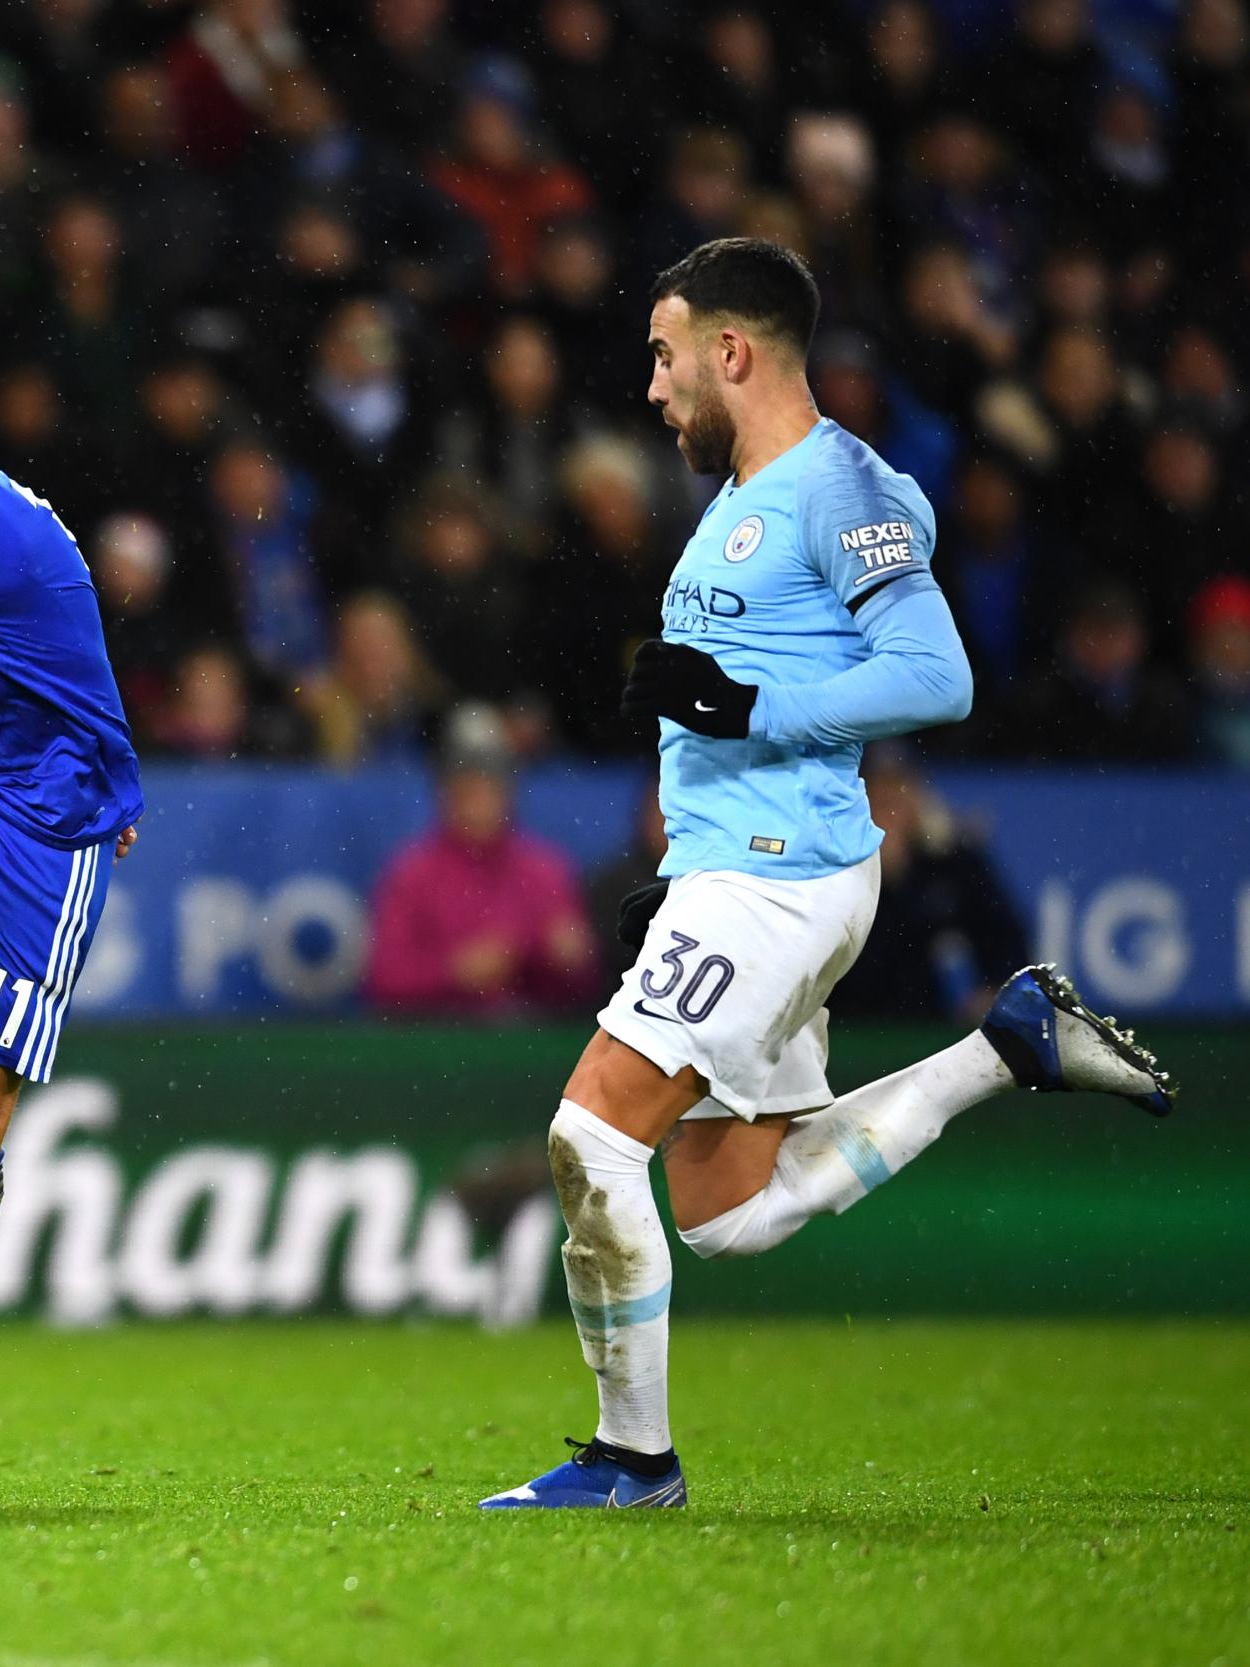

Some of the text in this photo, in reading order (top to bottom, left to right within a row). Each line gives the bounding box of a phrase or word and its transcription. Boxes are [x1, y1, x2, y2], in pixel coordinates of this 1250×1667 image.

[839, 521, 915, 552] NEXEN
[857, 541, 912, 569] TIRE
[640, 929, 735, 1024] 30
